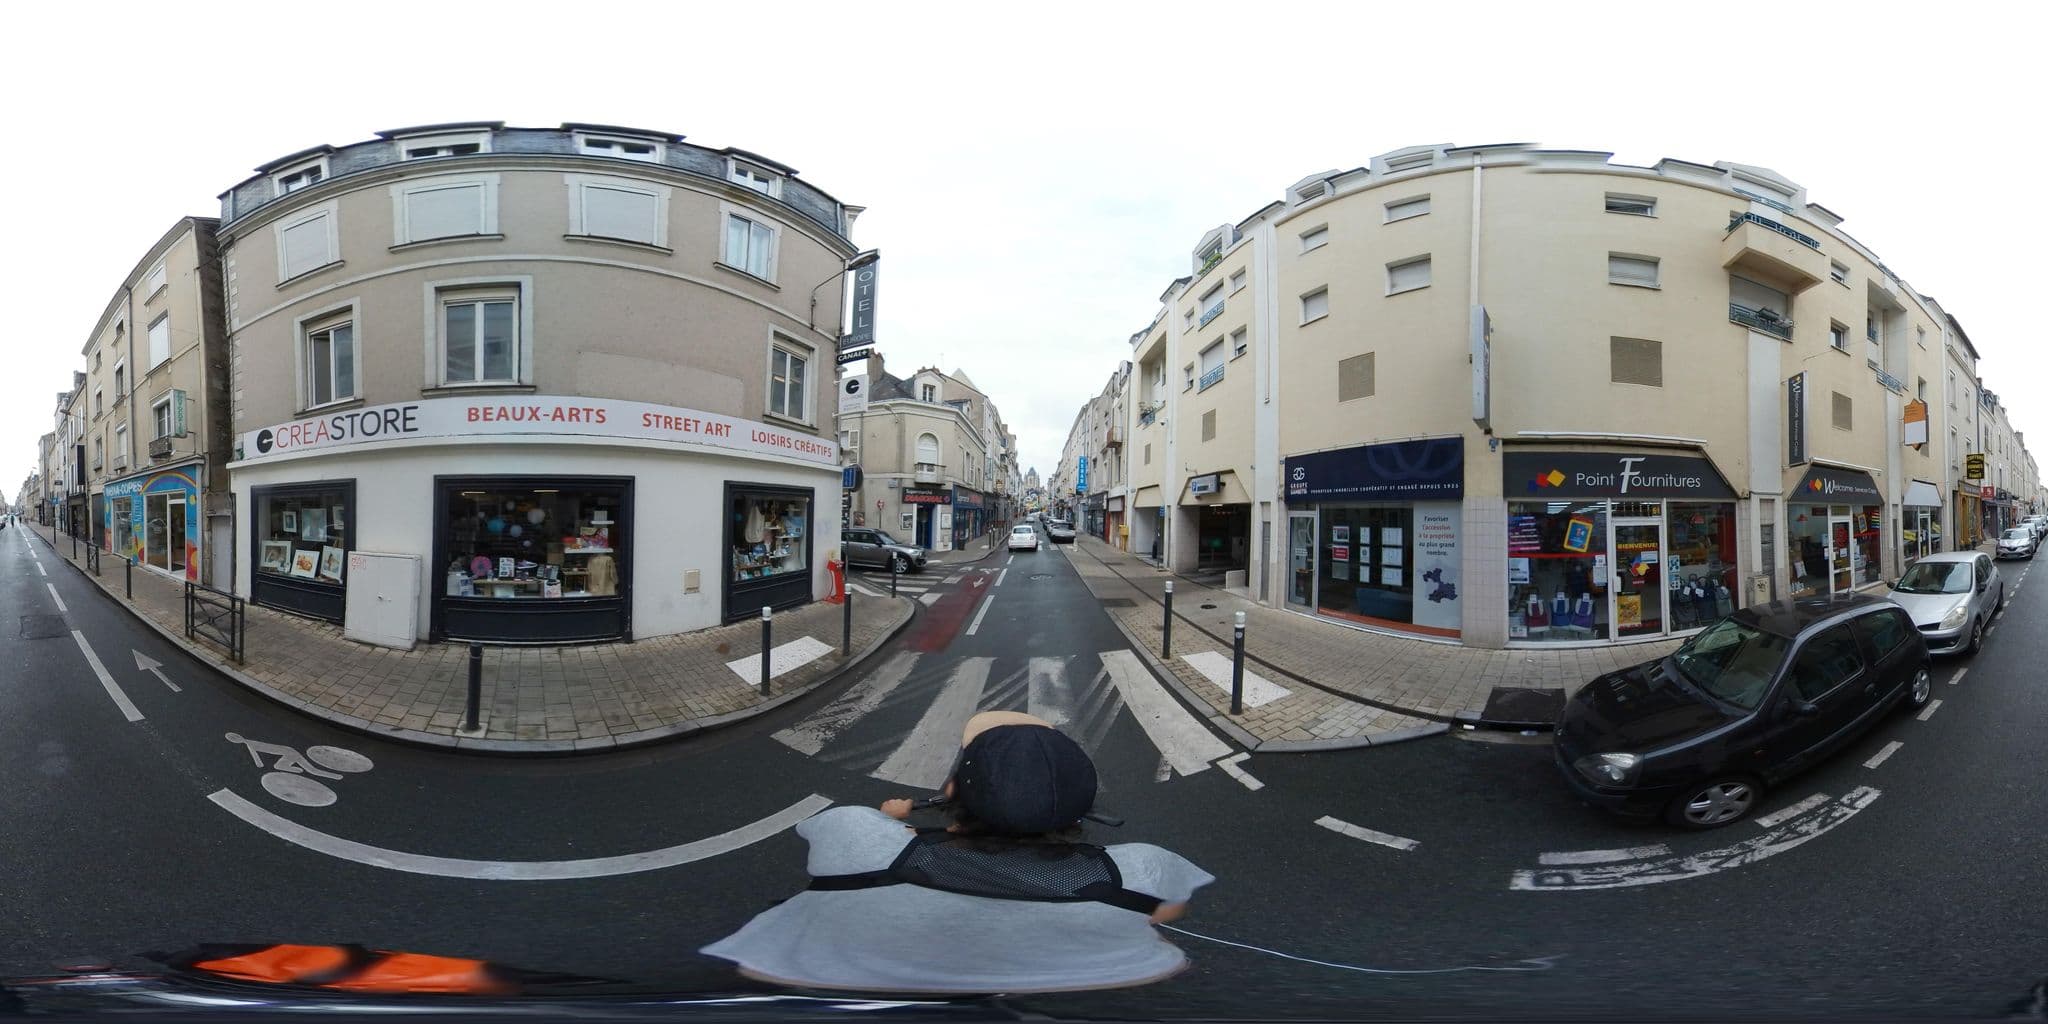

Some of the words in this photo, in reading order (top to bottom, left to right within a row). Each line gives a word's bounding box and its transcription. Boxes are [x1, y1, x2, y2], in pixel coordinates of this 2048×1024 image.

[858, 264, 873, 329] OTEL
[838, 350, 867, 362] CANAL+
[276, 405, 419, 449] CREASTORE
[467, 405, 607, 424] BEAUX-ARTS
[642, 412, 701, 433] STREET
[704, 422, 732, 438] ART
[751, 429, 792, 449] LOISIRS
[794, 438, 832, 458] CRÉATIFS
[1576, 470, 1614, 487] Point
[1619, 457, 1701, 494] Fournitures
[1823, 478, 1853, 495] Welcome
